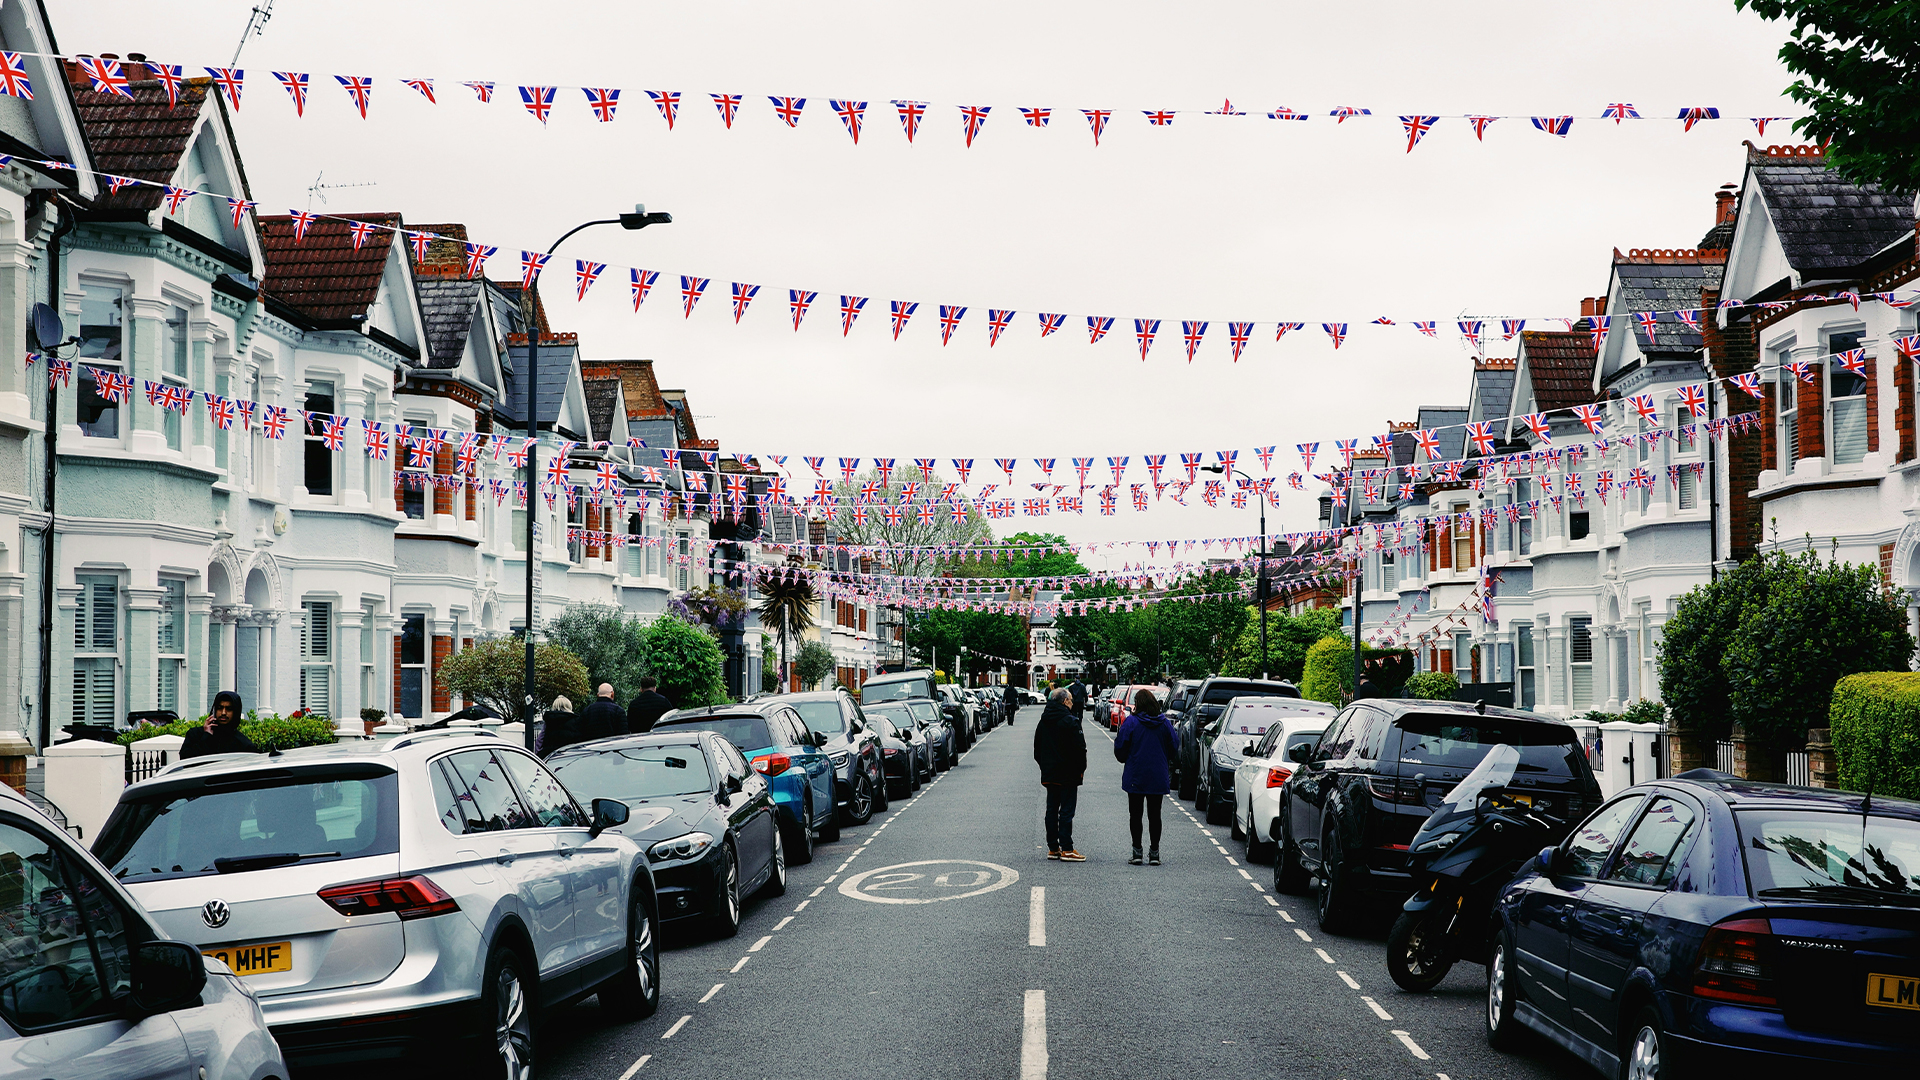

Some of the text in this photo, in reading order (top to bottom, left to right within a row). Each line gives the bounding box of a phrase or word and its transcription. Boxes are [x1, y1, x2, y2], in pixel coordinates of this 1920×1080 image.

[863, 871, 992, 891] 20
[1780, 939, 1847, 952] VAUXHALL
[236, 945, 281, 971] MHF
[1878, 978, 1920, 1005] LM
